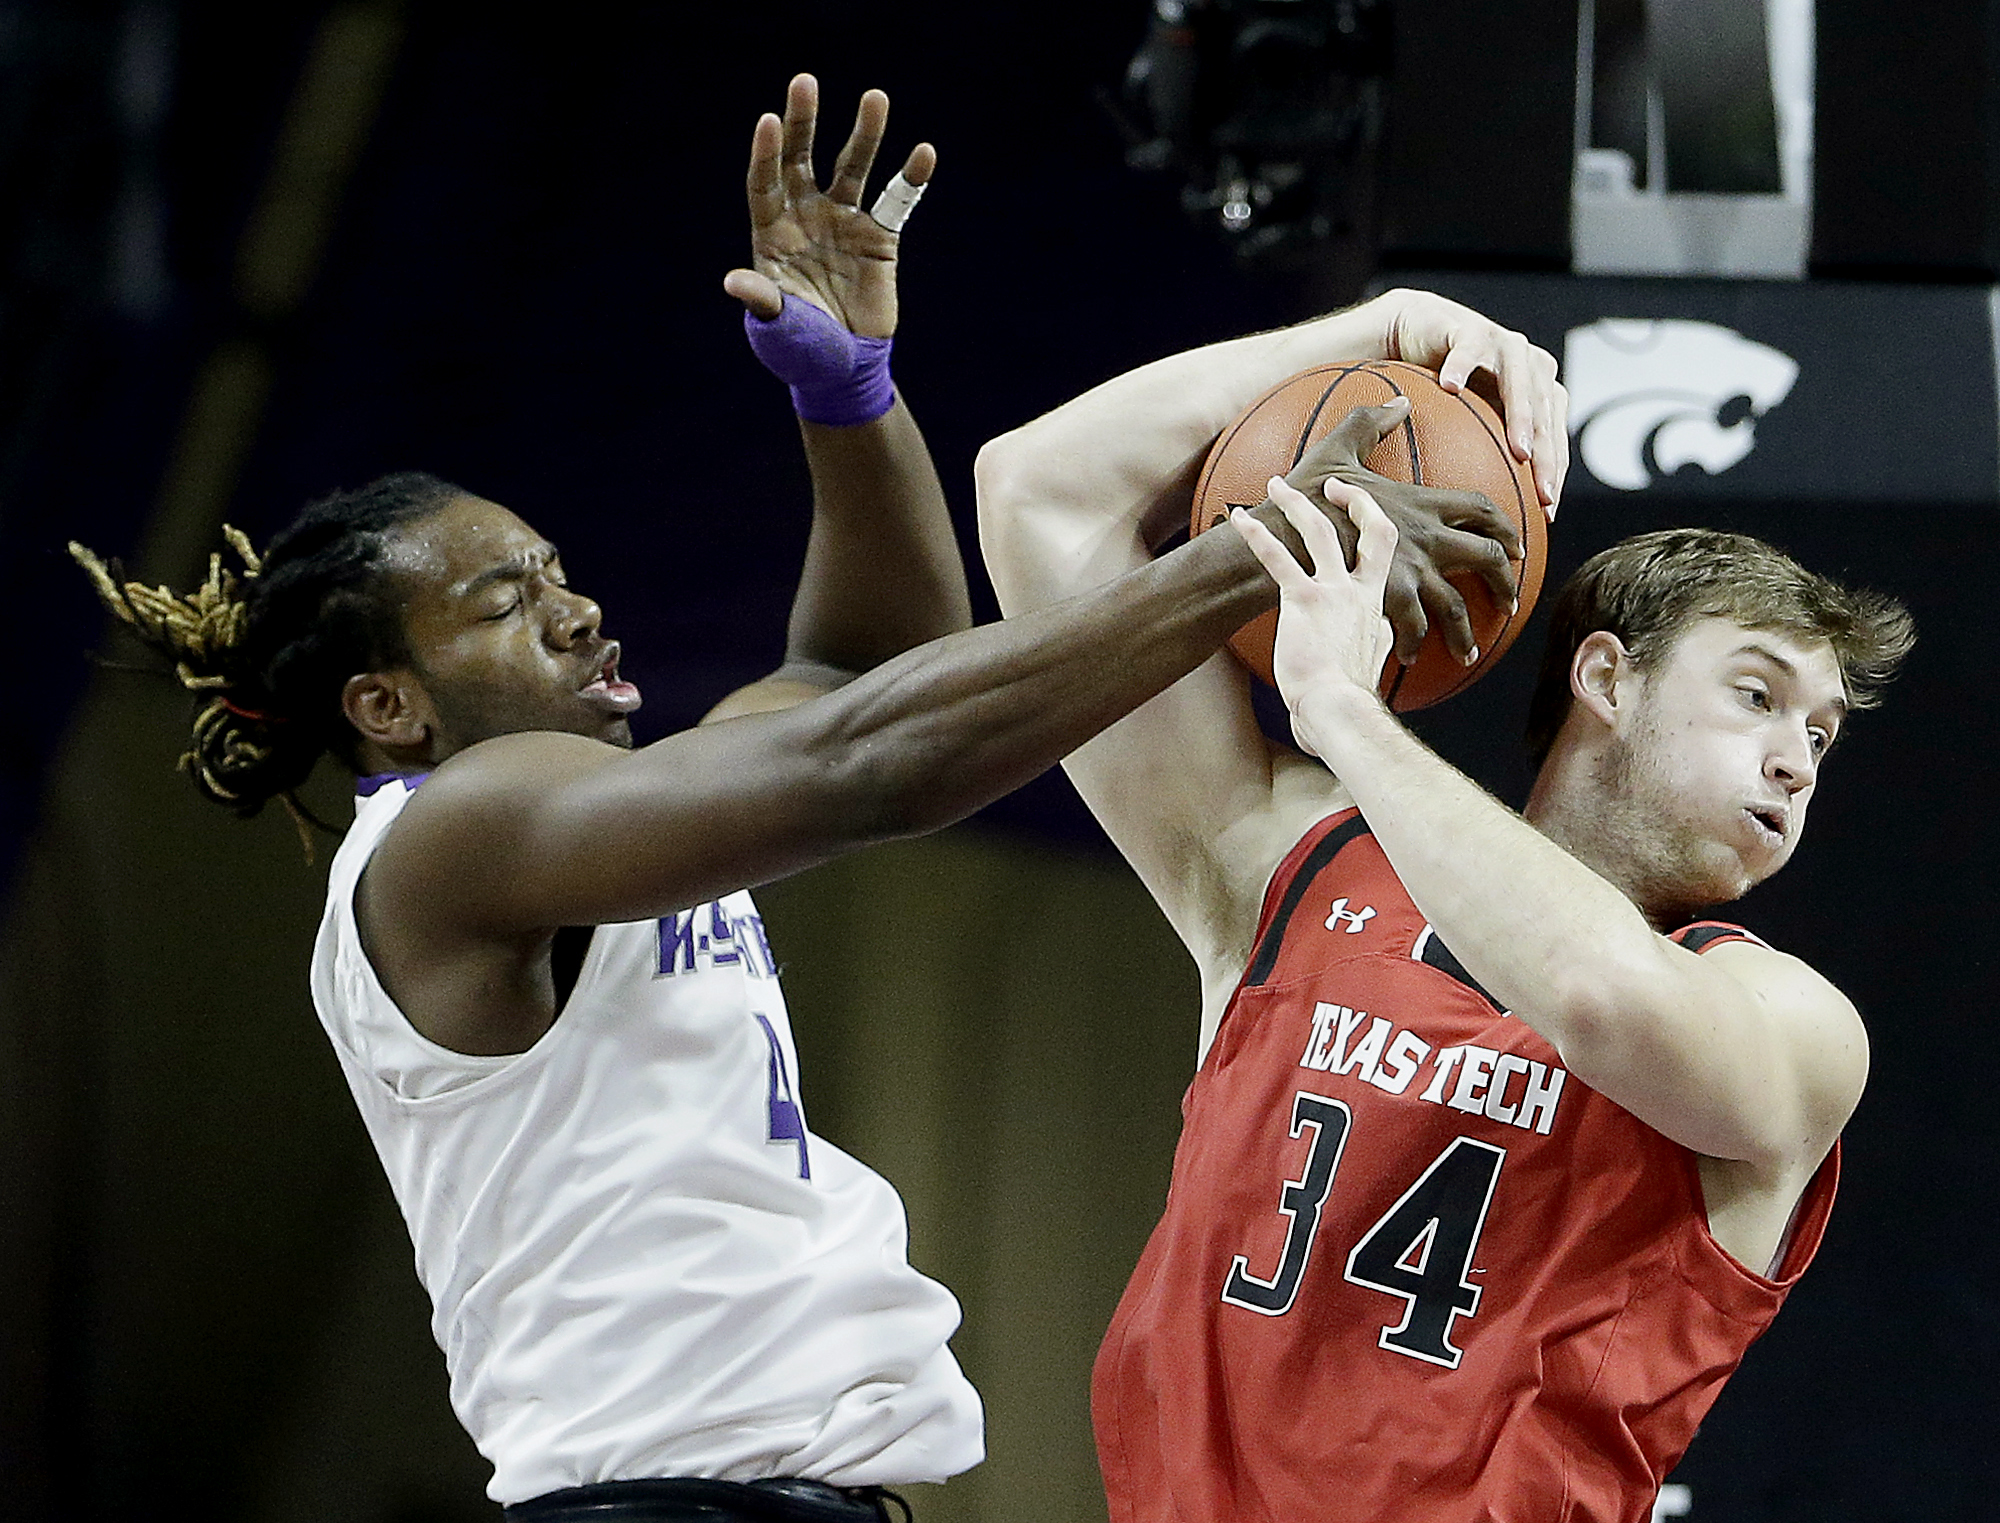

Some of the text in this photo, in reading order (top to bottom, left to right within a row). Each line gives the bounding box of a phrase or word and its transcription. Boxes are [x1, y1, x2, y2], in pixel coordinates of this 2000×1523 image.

[752, 1012, 811, 1181] 4
[1300, 1001, 1566, 1135] TEXAS TECH
[1221, 1091, 1507, 1369] 34
